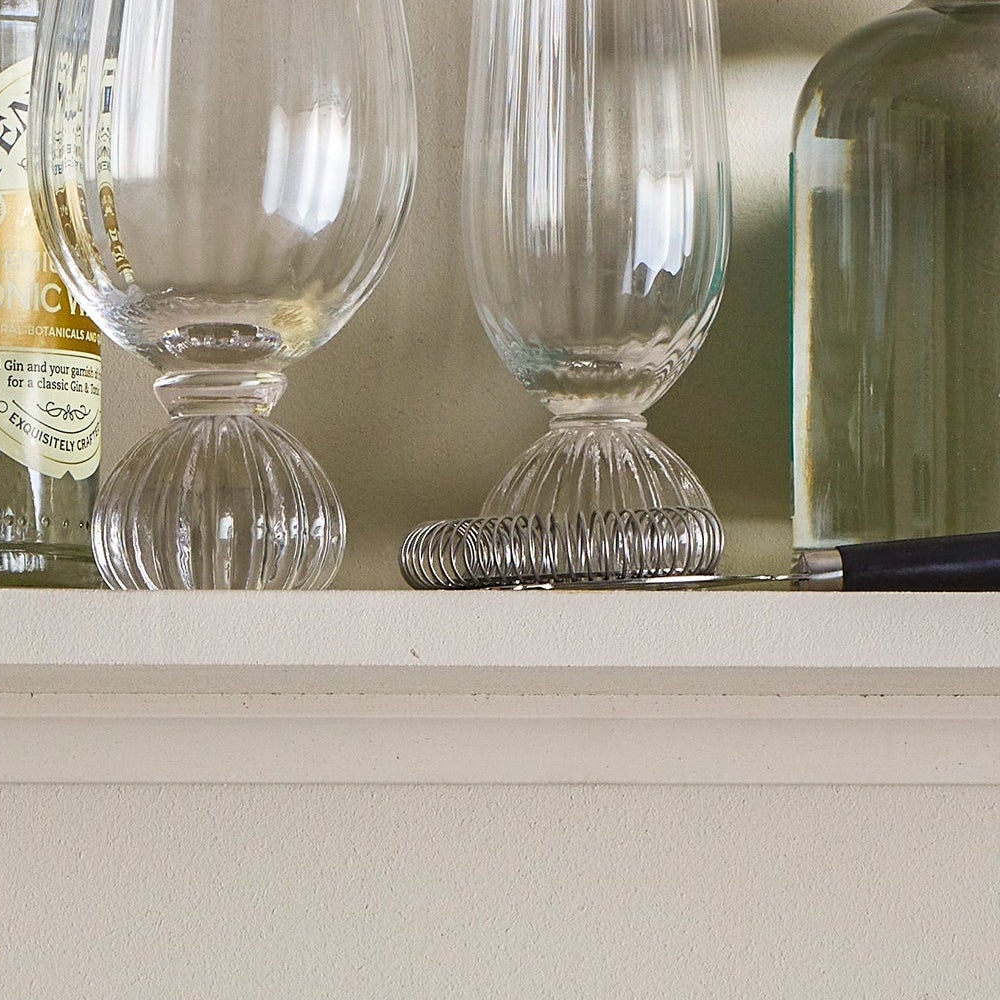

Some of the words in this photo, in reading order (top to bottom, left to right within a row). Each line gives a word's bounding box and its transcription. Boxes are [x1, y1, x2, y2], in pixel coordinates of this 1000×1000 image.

[27, 325, 85, 341] BOTANICALS
[4, 359, 24, 372] Gin
[27, 361, 47, 373] and
[49, 364, 69, 377] your
[7, 375, 25, 388] for
[27, 379, 34, 388] a
[37, 377, 69, 392] classic
[70, 380, 83, 393] Gin
[8, 411, 75, 452] EXQUISITELY
